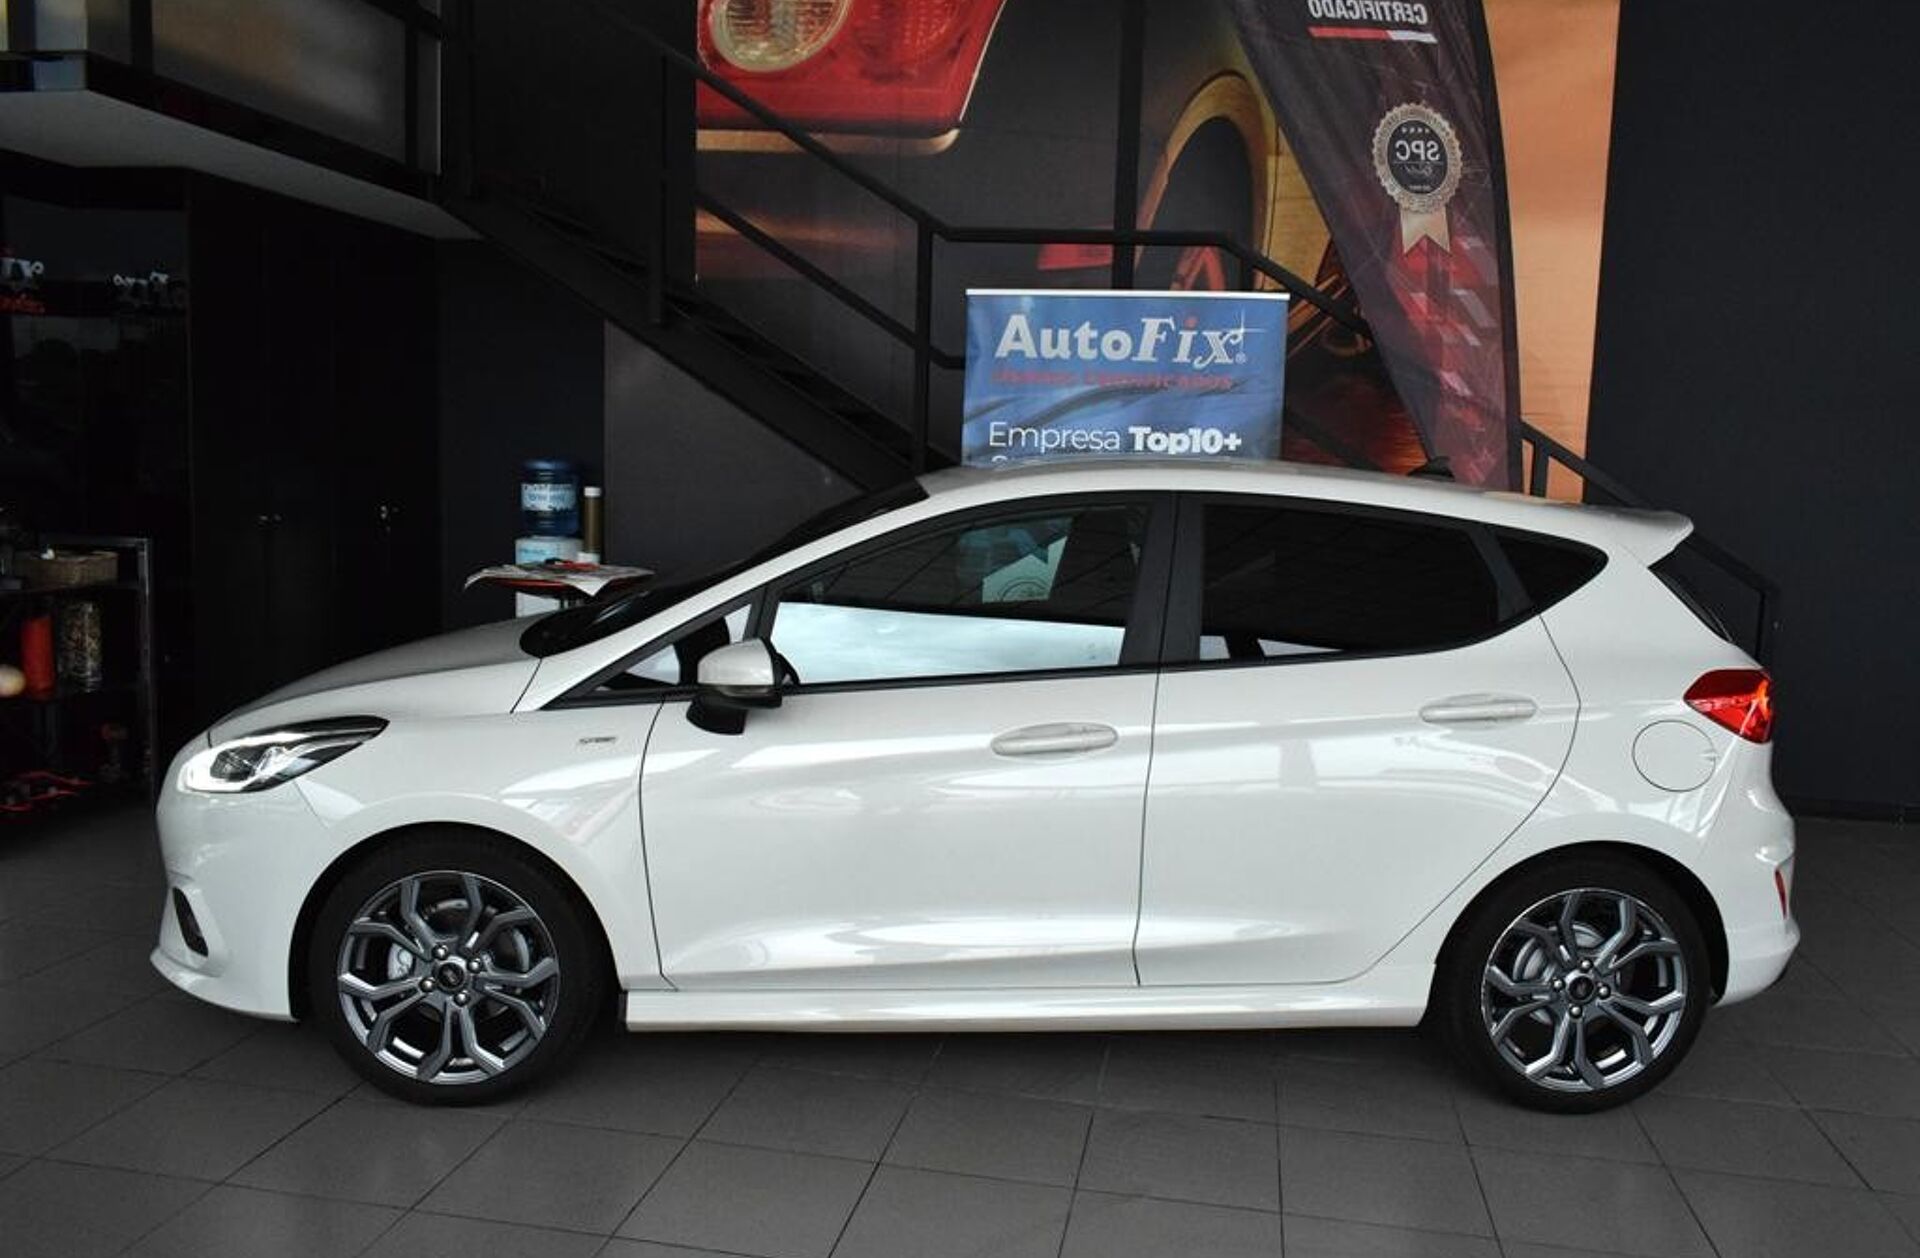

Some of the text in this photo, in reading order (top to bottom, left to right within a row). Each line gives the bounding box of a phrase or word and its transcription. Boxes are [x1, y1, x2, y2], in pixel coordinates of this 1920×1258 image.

[995, 314, 1239, 368] AutoFix
[989, 421, 1243, 455] Empresa Top10+
